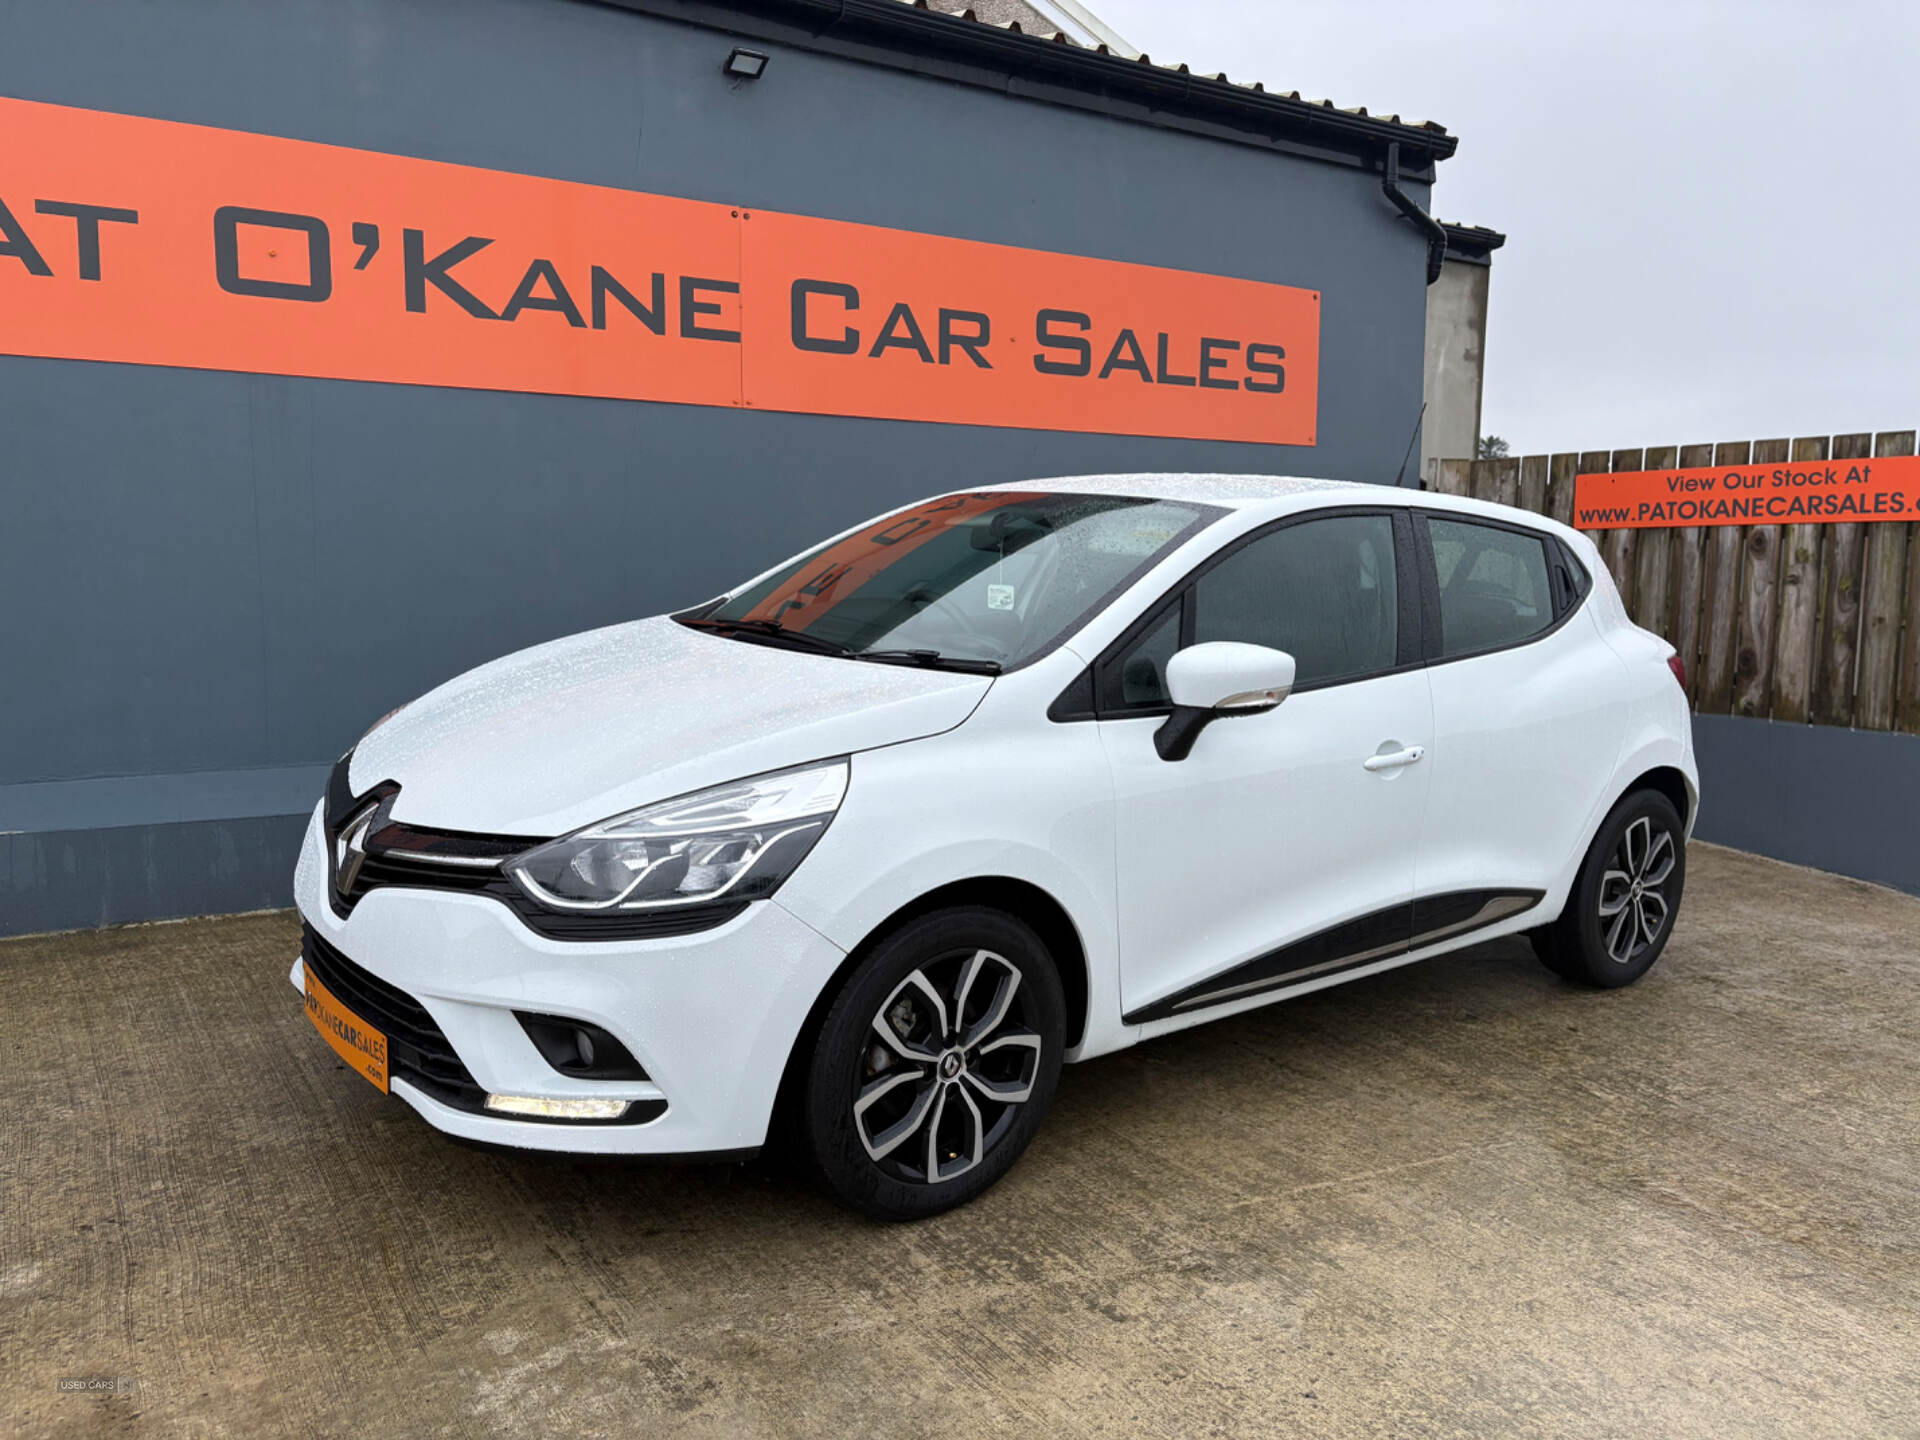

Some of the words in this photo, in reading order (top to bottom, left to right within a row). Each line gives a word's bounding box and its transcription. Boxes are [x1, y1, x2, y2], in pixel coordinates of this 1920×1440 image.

[213, 205, 742, 343] O'KANE
[791, 278, 994, 368] CAR
[1033, 308, 1286, 393] SALES
[1666, 475, 1716, 493] View
[1723, 472, 1765, 490] Our
[1771, 467, 1837, 488] Stock
[1844, 465, 1871, 484] At
